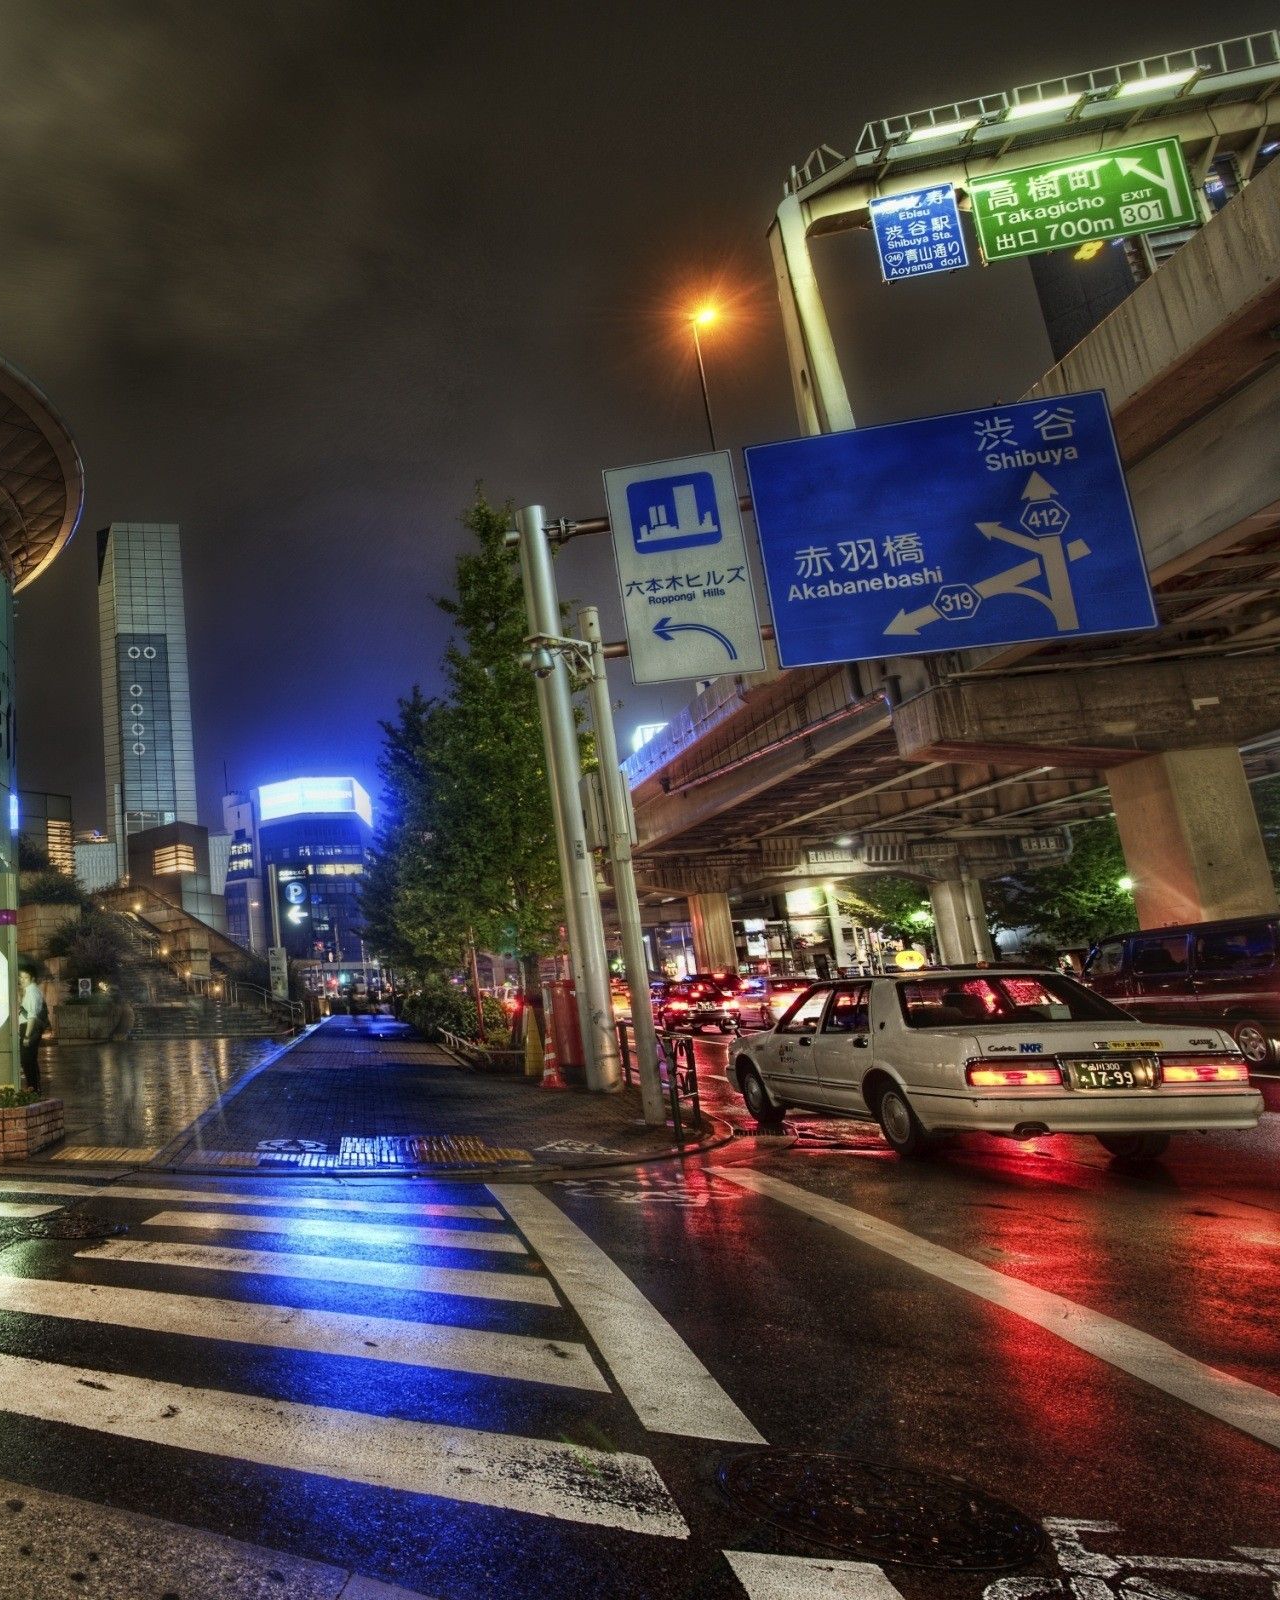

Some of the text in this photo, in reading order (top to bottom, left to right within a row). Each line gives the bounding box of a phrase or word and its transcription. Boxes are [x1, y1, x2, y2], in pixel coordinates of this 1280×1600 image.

[1121, 188, 1153, 202] EXIT
[899, 209, 930, 221] Ebisu
[992, 195, 1105, 226] Takagicho
[1123, 203, 1162, 225] 301
[885, 215, 952, 242] 渋谷駅
[996, 216, 1115, 251] 出口 700m
[887, 232, 953, 250] Shibuya Sta.
[887, 241, 961, 265] 246 青山通り
[890, 255, 962, 277] Aoyama dori
[973, 407, 1076, 452] 渋谷
[985, 446, 1078, 472] Shibuya
[1028, 508, 1063, 528] 412
[794, 532, 925, 579] 赤羽橋
[625, 565, 746, 597] 六本木ヒルズ
[788, 566, 943, 602] Akabanebashi
[648, 587, 726, 605] Roppongi Hills
[940, 592, 974, 612] 319
[1090, 1071, 1134, 1086] 17-99
